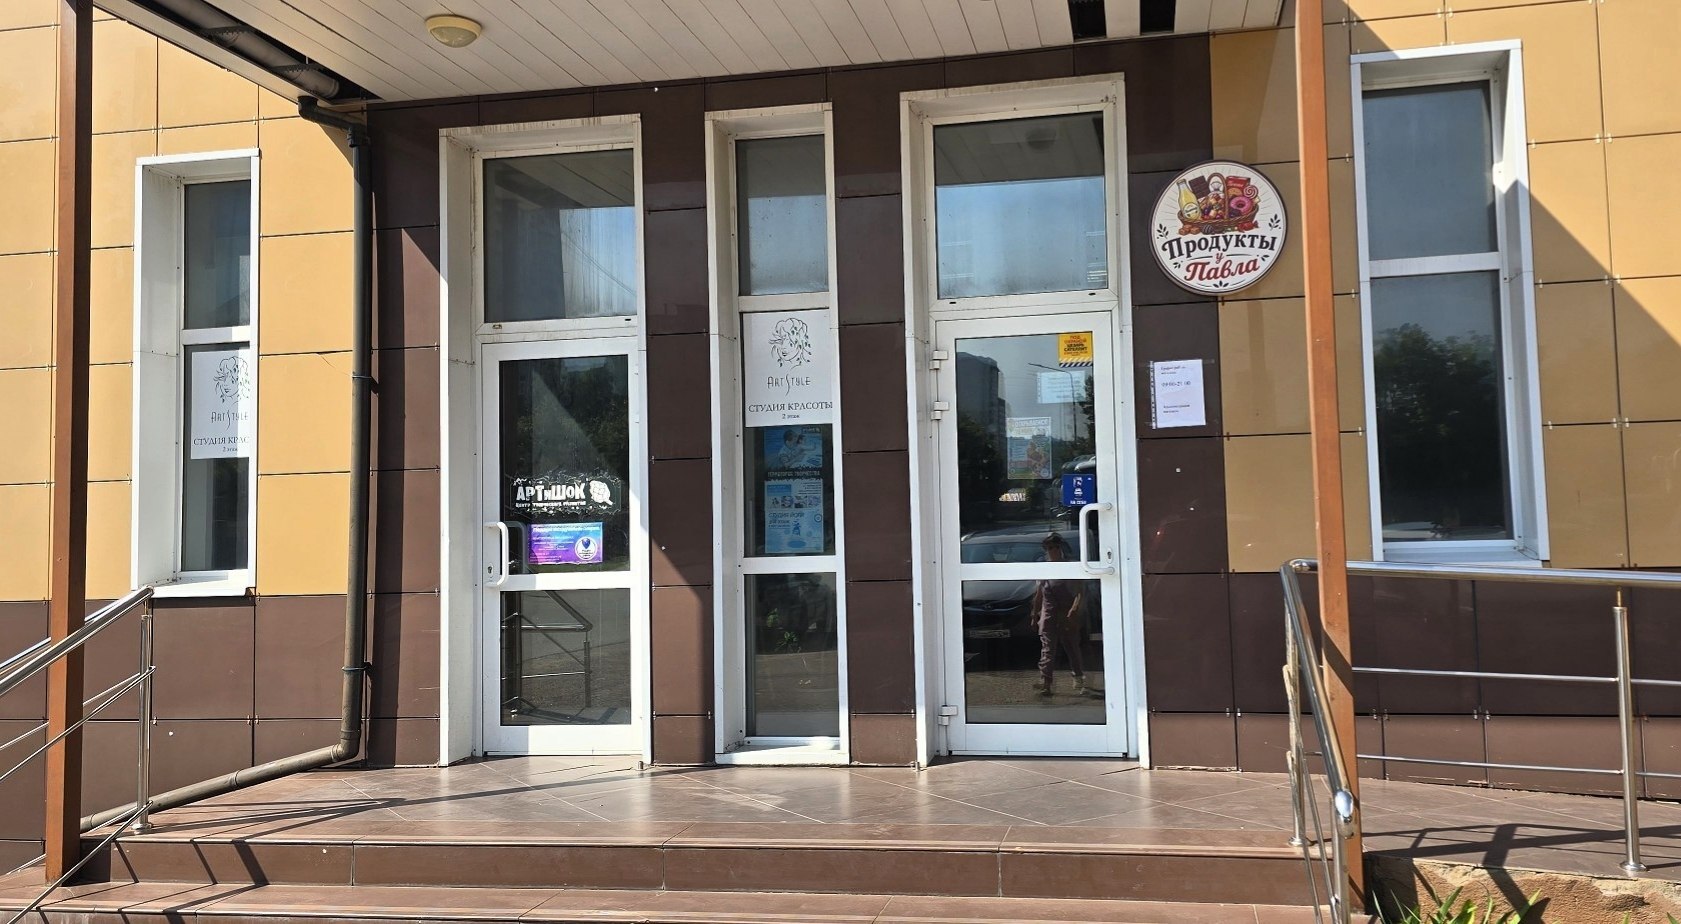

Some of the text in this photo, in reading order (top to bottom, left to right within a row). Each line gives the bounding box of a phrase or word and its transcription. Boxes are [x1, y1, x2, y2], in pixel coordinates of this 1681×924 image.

[1161, 234, 1277, 260] Продукты
[1215, 252, 1224, 264] у
[1184, 258, 1260, 282] Павла
[748, 402, 833, 413] СТУДИЯ КРАСОТЫ
[193, 437, 226, 446] СТУДИЯ
